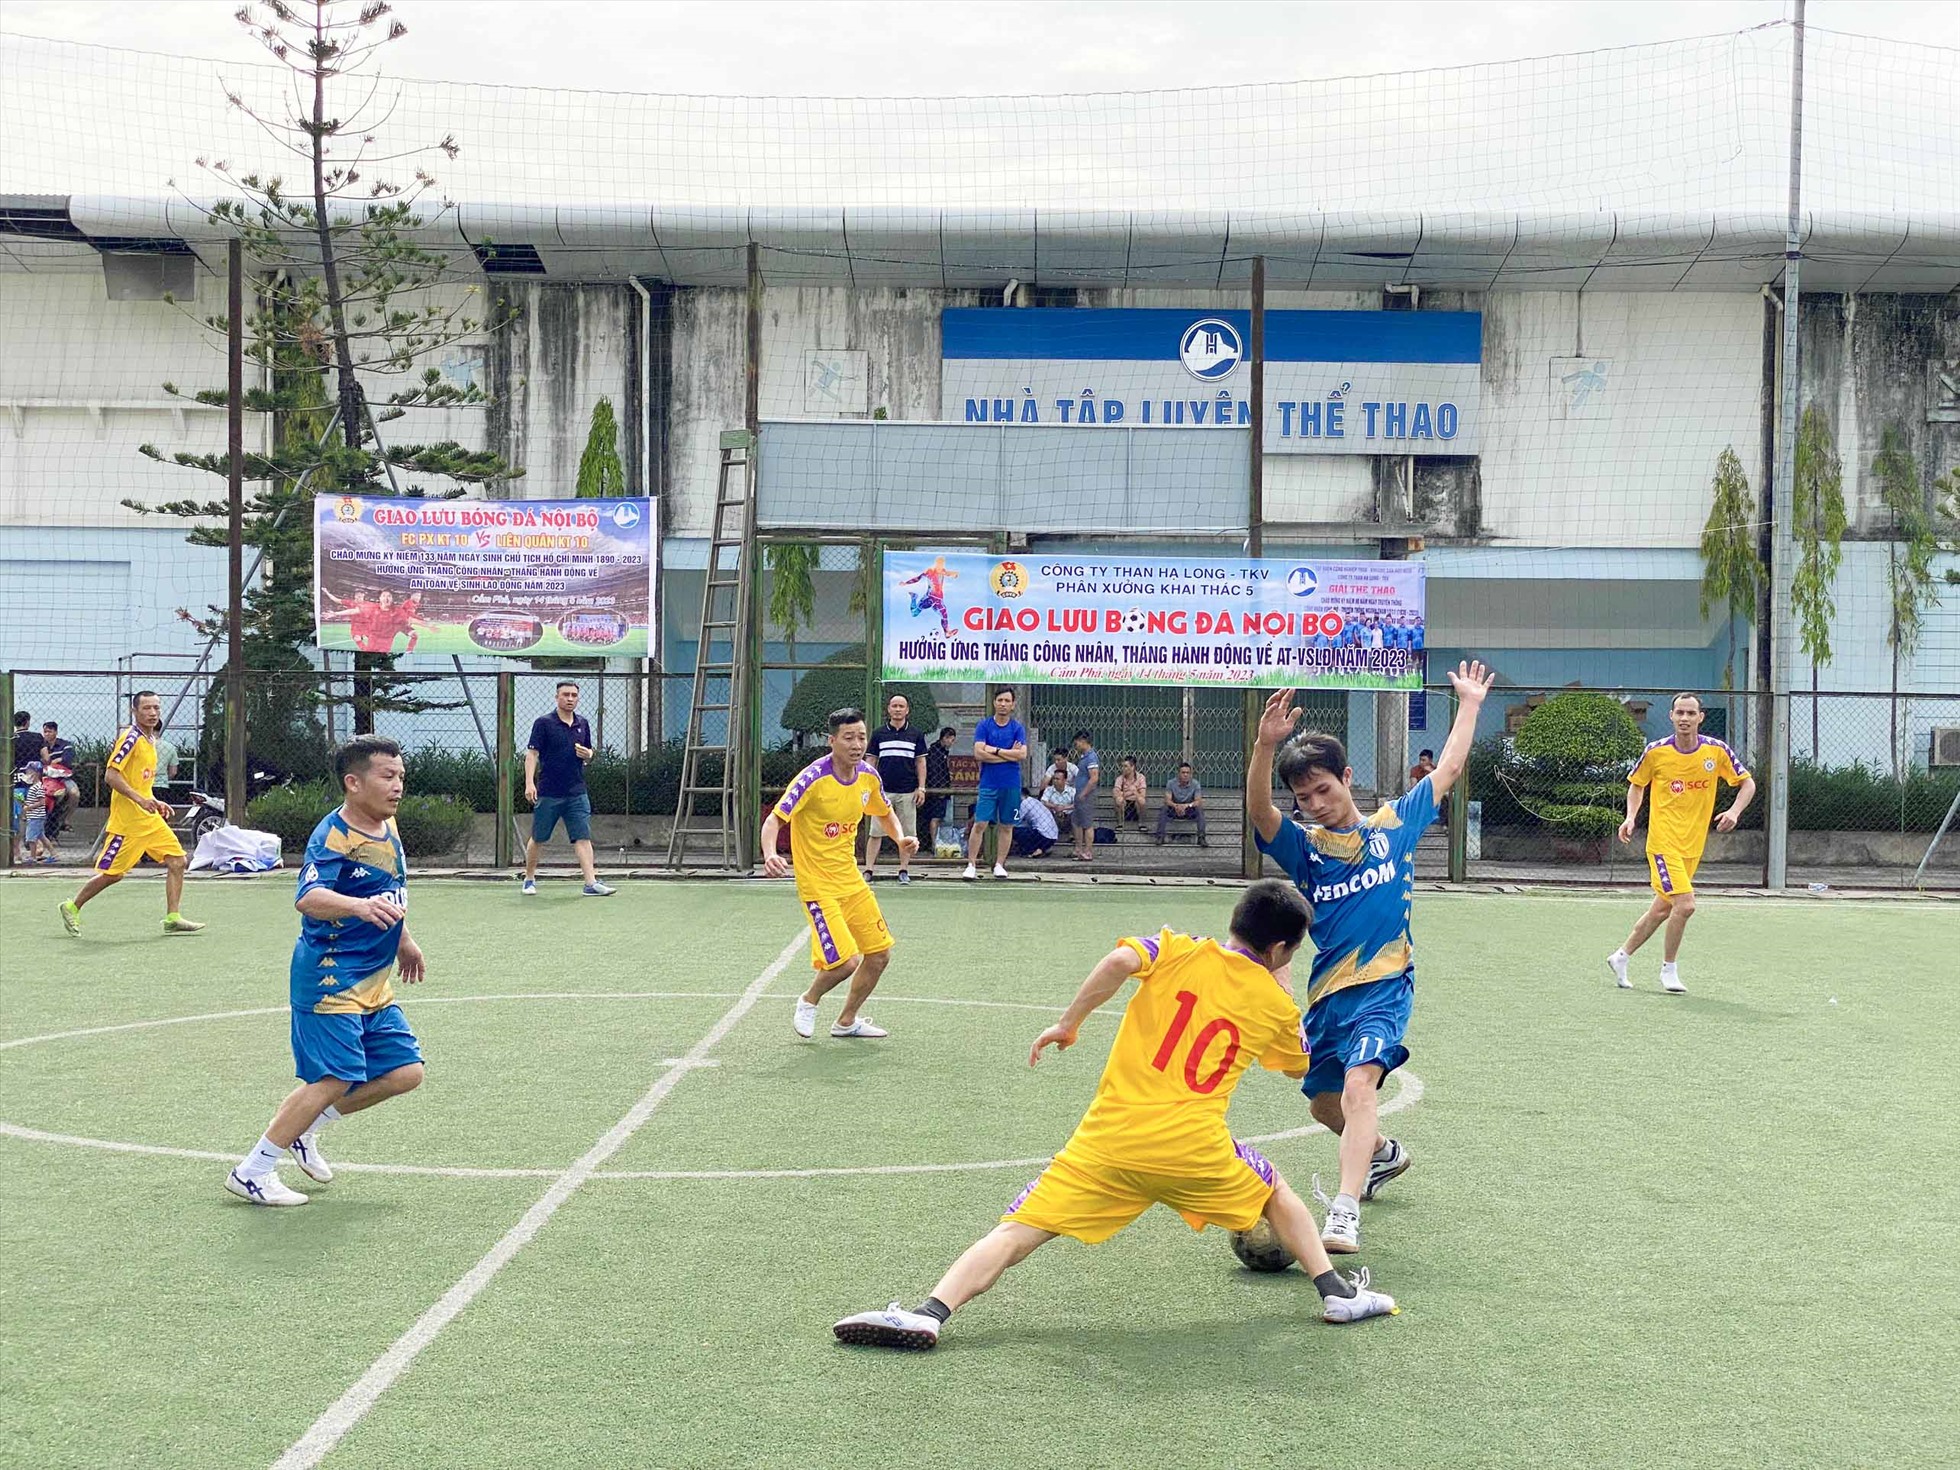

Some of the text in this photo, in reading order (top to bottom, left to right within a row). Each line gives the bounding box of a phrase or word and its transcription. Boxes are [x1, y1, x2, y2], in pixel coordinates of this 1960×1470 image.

[1277, 382, 1351, 438] THỂ
[1361, 402, 1459, 440] THAO
[374, 508, 599, 531] GIAO LƯU BÓNG ĐÁ NỘI BỘ
[401, 533, 416, 546] FC
[419, 533, 434, 546] PX
[437, 533, 451, 546] KT
[455, 533, 469, 546] 10
[496, 532, 521, 547] LIÊN
[523, 532, 555, 548] QUÂN
[558, 534, 572, 548] KT
[576, 535, 589, 548] 10
[420, 552, 435, 560] 133
[483, 553, 502, 562] SINH
[572, 554, 593, 563] MINH
[595, 554, 615, 563] 1890
[622, 554, 642, 564] 2023
[1041, 563, 1084, 577] CÔNG
[1090, 567, 1108, 577] TY
[1113, 567, 1153, 578] THAN
[1159, 568, 1179, 580] HẠ
[1184, 568, 1225, 579] LONG
[1240, 569, 1269, 580] TKV
[411, 580, 423, 588] AN
[461, 580, 480, 589] SINH
[483, 581, 498, 590] LAO
[546, 582, 565, 591] 2023
[1056, 579, 1254, 596] PHÂN XƯỞNG KHAI THÁC 5
[963, 607, 1040, 632] GIAO
[1048, 609, 1098, 633] LƯU
[1195, 608, 1235, 635] ĐÁ
[1243, 610, 1294, 638] NỘI
[1302, 610, 1343, 639] BỘ
[899, 635, 1407, 669] HƯỞNG ỨNG THÁNG CÔNG NHÂN, THÁNG HÀNH ĐỘNG VỀ AT-VSLĐ NĂM 2023
[1107, 668, 1133, 681] ngày
[1154, 667, 1185, 681] tháng
[1198, 669, 1224, 680] năm
[1227, 669, 1254, 681] 2023
[1687, 780, 1709, 790] SCC
[1151, 990, 1241, 1094] 10
[1358, 1036, 1384, 1060] 11
